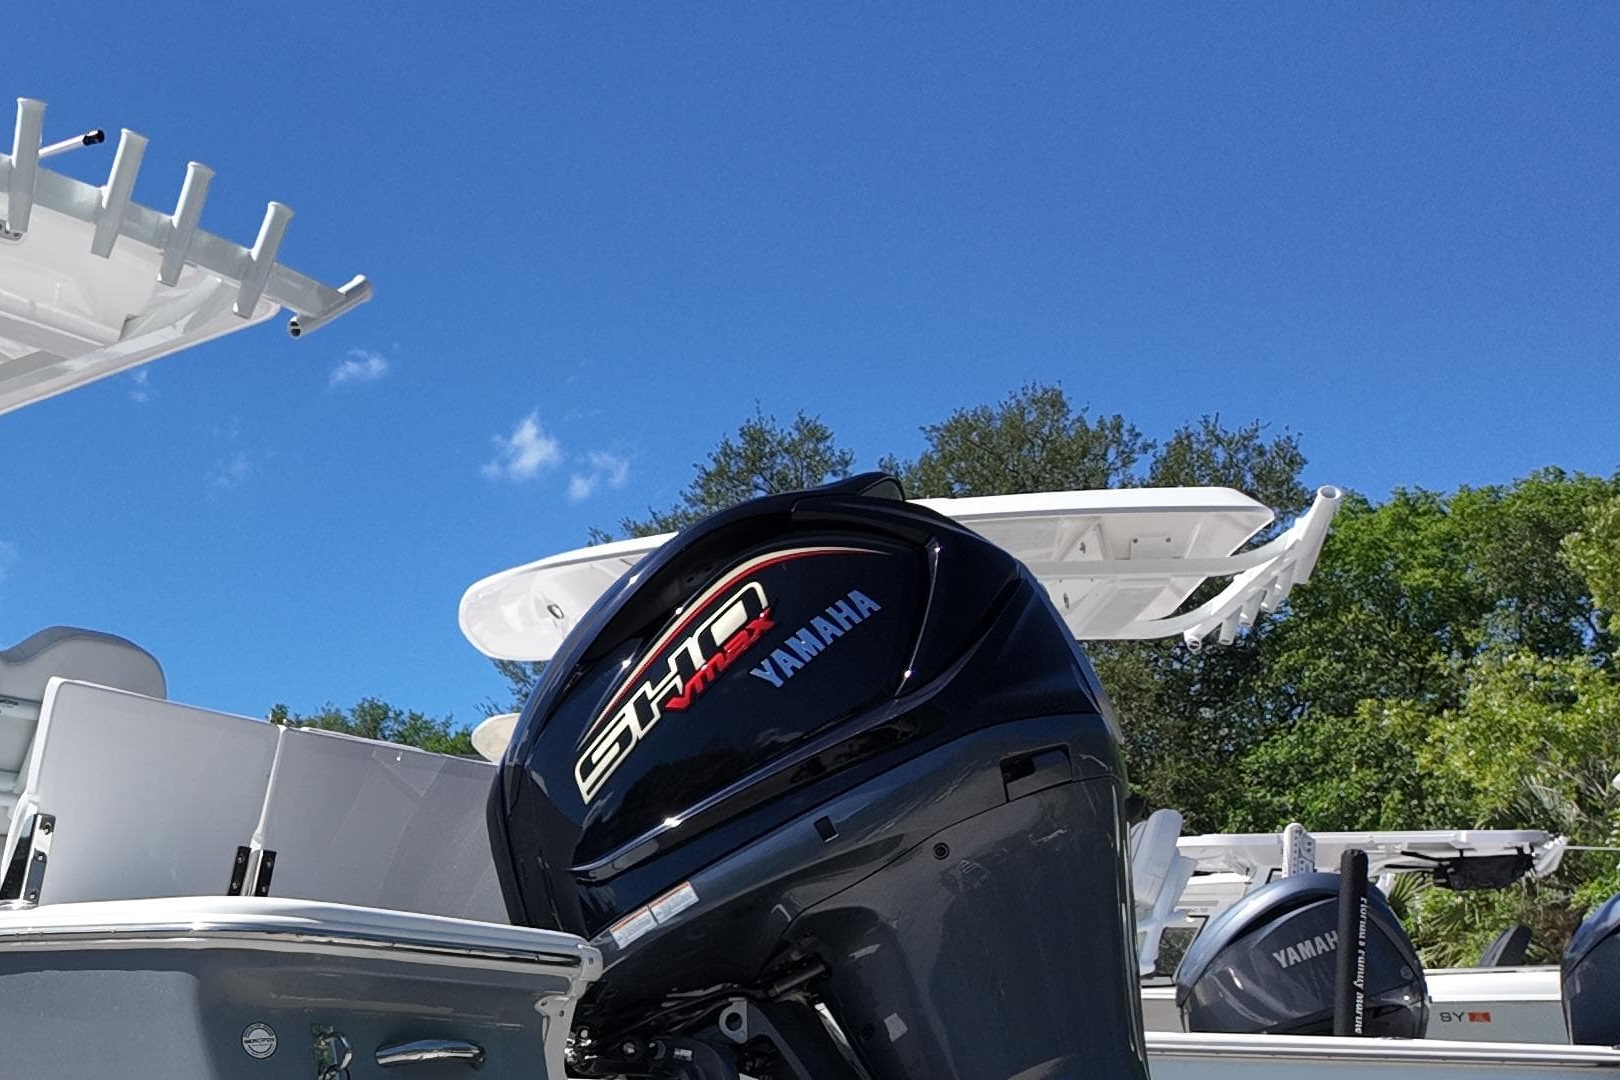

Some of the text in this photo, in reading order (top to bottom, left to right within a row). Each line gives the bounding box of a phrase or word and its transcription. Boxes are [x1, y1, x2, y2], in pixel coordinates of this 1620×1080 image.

[749, 590, 882, 688] YAMAHA
[574, 581, 769, 805] SHO
[1272, 929, 1340, 969] YAMAH
